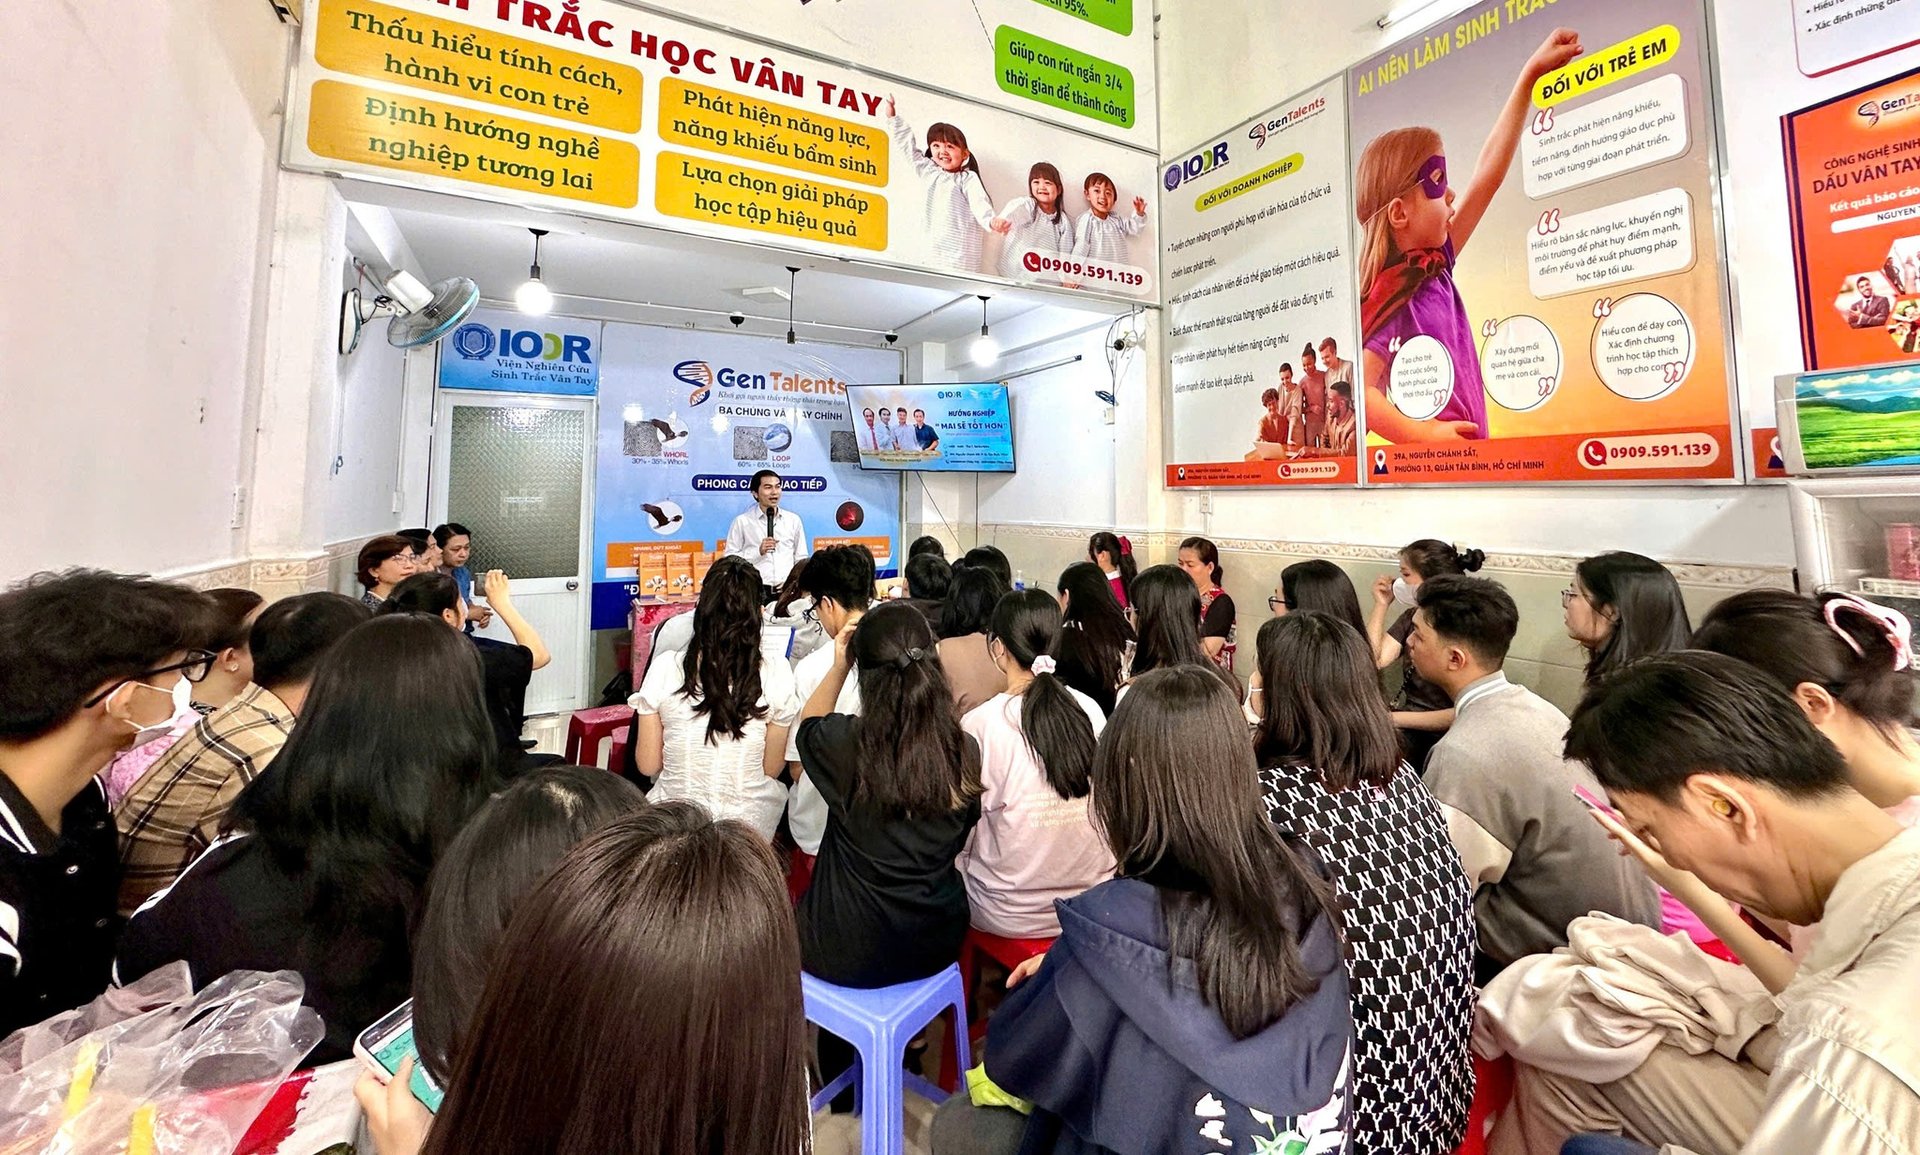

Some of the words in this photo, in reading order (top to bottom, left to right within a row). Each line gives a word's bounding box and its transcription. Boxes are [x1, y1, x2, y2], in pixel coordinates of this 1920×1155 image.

[1815, 21, 1831, 31] Xác
[1833, 10, 1853, 24] định
[347, 10, 423, 44] Thấu
[432, 30, 491, 60] hiểu
[500, 49, 552, 75] tính
[559, 66, 623, 94] cách,
[497, 0, 614, 48] TRẮC
[631, 30, 717, 75] HỌC
[730, 57, 804, 97] VÂN
[817, 80, 882, 117] TAY
[1359, 70, 1374, 97] AI
[1378, 53, 1409, 87] NÊN
[1414, 32, 1450, 70] LÀM
[1455, 7, 1500, 49] SINH
[1009, 41, 1035, 64] Giúp
[1038, 52, 1056, 68] con
[1059, 58, 1074, 75] rút
[1077, 64, 1101, 84] ngắn
[1106, 74, 1122, 91] 3/4
[1543, 73, 1570, 99] ĐỐI
[1575, 63, 1604, 86] VỚI
[1609, 46, 1636, 73] TRẺ
[1642, 38, 1667, 60] EM
[385, 53, 459, 86] hành
[467, 75, 492, 93] vi
[500, 84, 545, 106] con
[553, 93, 589, 115] trẻ
[1006, 69, 1028, 88] thời
[1032, 77, 1054, 95] gian
[1057, 83, 1070, 101] để
[1073, 90, 1101, 112] thành
[1104, 100, 1126, 122] công
[684, 90, 734, 115] Phát
[739, 102, 781, 127] hiện
[788, 117, 834, 142] năng
[840, 128, 870, 150] lực,
[1267, 97, 1325, 131] GenTalents
[365, 97, 436, 127] Định
[444, 112, 530, 150] hướng
[538, 134, 600, 160] nghề
[1539, 136, 1556, 147] Sinh
[1573, 123, 1591, 138] phát
[674, 119, 727, 145] năng
[734, 130, 788, 153] khiếu
[795, 142, 834, 167] bẩm
[840, 157, 877, 175] sinh
[1602, 150, 1624, 162] đoạn
[1626, 142, 1645, 155] phát
[1824, 155, 1855, 170] CÔNG
[1858, 145, 1890, 162] NGHỆ
[1893, 138, 1920, 153] SINH
[369, 136, 469, 171] nghiệp
[477, 157, 555, 187] tương
[562, 168, 593, 190] lai
[683, 162, 722, 185] Lựa
[728, 172, 777, 195] chọn
[783, 183, 818, 201] giải
[823, 192, 869, 215] pháp
[1204, 193, 1216, 206] ĐỐI
[1218, 188, 1231, 200] VỚI
[1233, 176, 1260, 194] DOANH
[1262, 162, 1292, 181] NGHIỆP
[1813, 172, 1848, 193] DẤU
[1851, 163, 1888, 184] VÂN
[695, 193, 732, 216] học
[737, 202, 771, 223] tập
[777, 208, 818, 232] hiệu
[823, 220, 857, 237] quả
[1830, 201, 1848, 212] Kết
[1877, 207, 1916, 221] NGUYEN
[1589, 238, 1608, 253] phát
[1610, 234, 1626, 247] huy
[1654, 239, 1678, 253] pháp
[1042, 258, 1143, 285] 0909.591.139
[1577, 271, 1591, 282] học
[1621, 326, 1635, 334] con
[492, 369, 518, 380] Sinh
[521, 371, 547, 381] Trắc
[550, 375, 571, 383] Vân
[573, 376, 593, 386] Tay
[496, 359, 521, 369] Viện
[526, 361, 564, 372] Nghiên
[569, 364, 590, 373] Cứu
[1635, 365, 1649, 373] cho
[717, 368, 765, 389] Gen
[770, 372, 846, 395] Talents
[719, 406, 733, 414] BA
[815, 412, 842, 420] CHÍNH
[1610, 444, 1711, 458] 0909.591.139
[1292, 466, 1336, 474] 0909.591.139
[1523, 461, 1544, 469] MINH
[698, 480, 736, 488] PHONG
[801, 478, 822, 489] TIẾP
